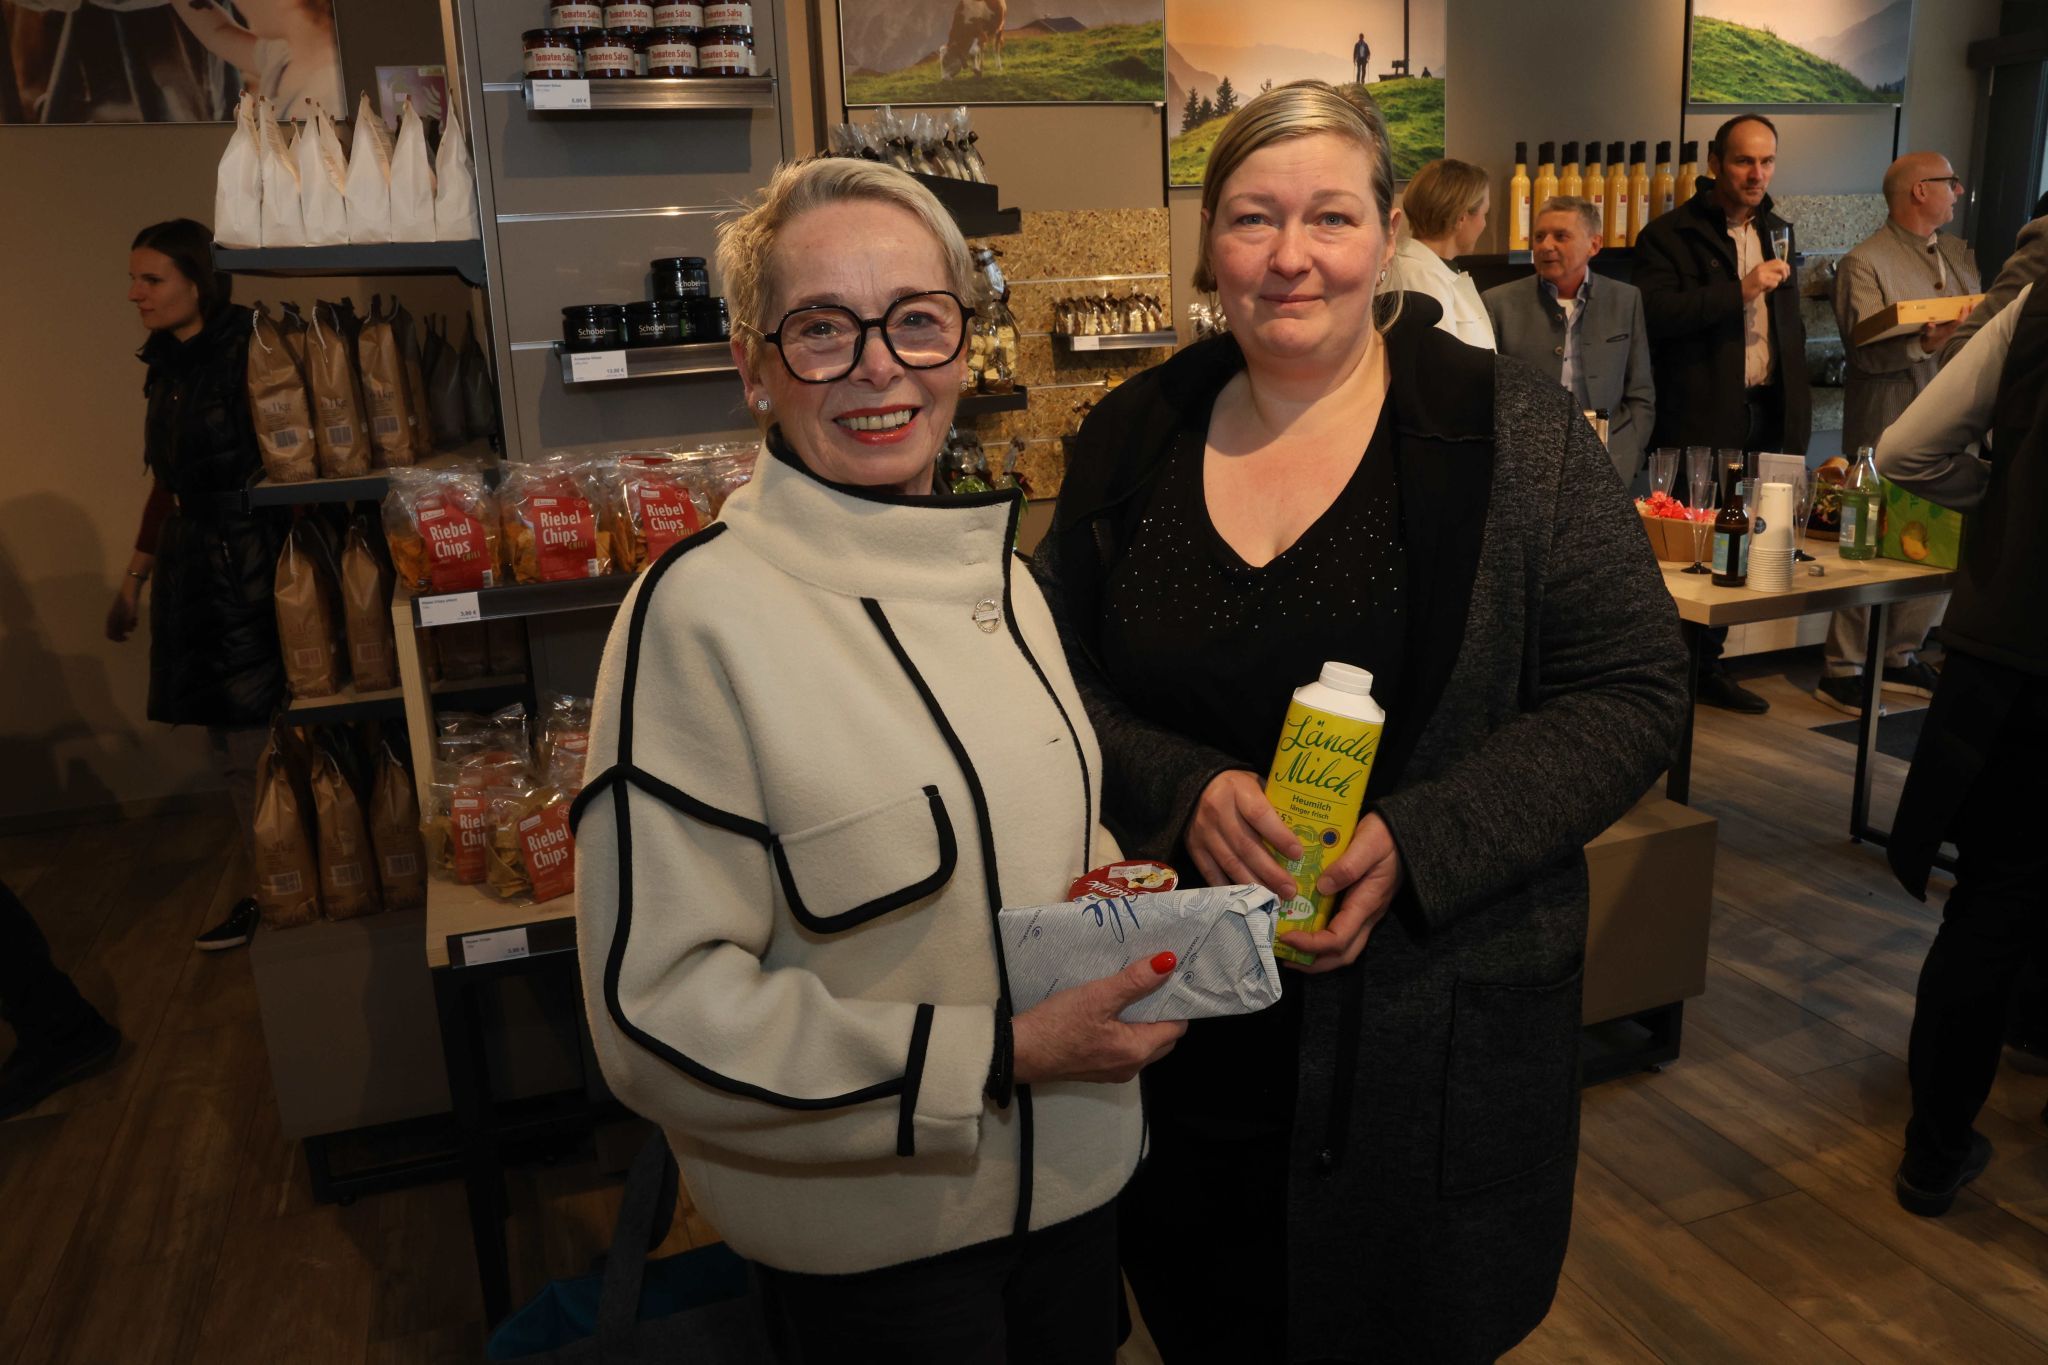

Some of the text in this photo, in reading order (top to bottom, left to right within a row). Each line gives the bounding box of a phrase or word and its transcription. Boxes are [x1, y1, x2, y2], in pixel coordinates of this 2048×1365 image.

[633, 8, 648, 18] Salsa
[675, 9, 691, 18] Salsa
[726, 8, 743, 18] Salsa
[535, 53, 561, 62] Tomaten
[613, 51, 629, 61] Salsa
[676, 49, 692, 59] Salsa
[722, 49, 740, 59] Salsa
[675, 280, 701, 288] Schobel
[578, 327, 606, 337] Schobel
[639, 322, 666, 332] Schobel
[646, 502, 685, 517] Riebel
[540, 510, 581, 528] Riebel
[651, 517, 685, 533] Chips
[429, 518, 472, 541] Riebel
[542, 527, 578, 547] Chips
[434, 539, 471, 559] Chips
[1280, 715, 1379, 766] Ländle
[1275, 751, 1363, 798] Milch
[1292, 794, 1332, 812] Heumilch
[1290, 804, 1329, 821] länger frisch
[527, 823, 569, 852] Riebel
[533, 846, 569, 870] Chips
